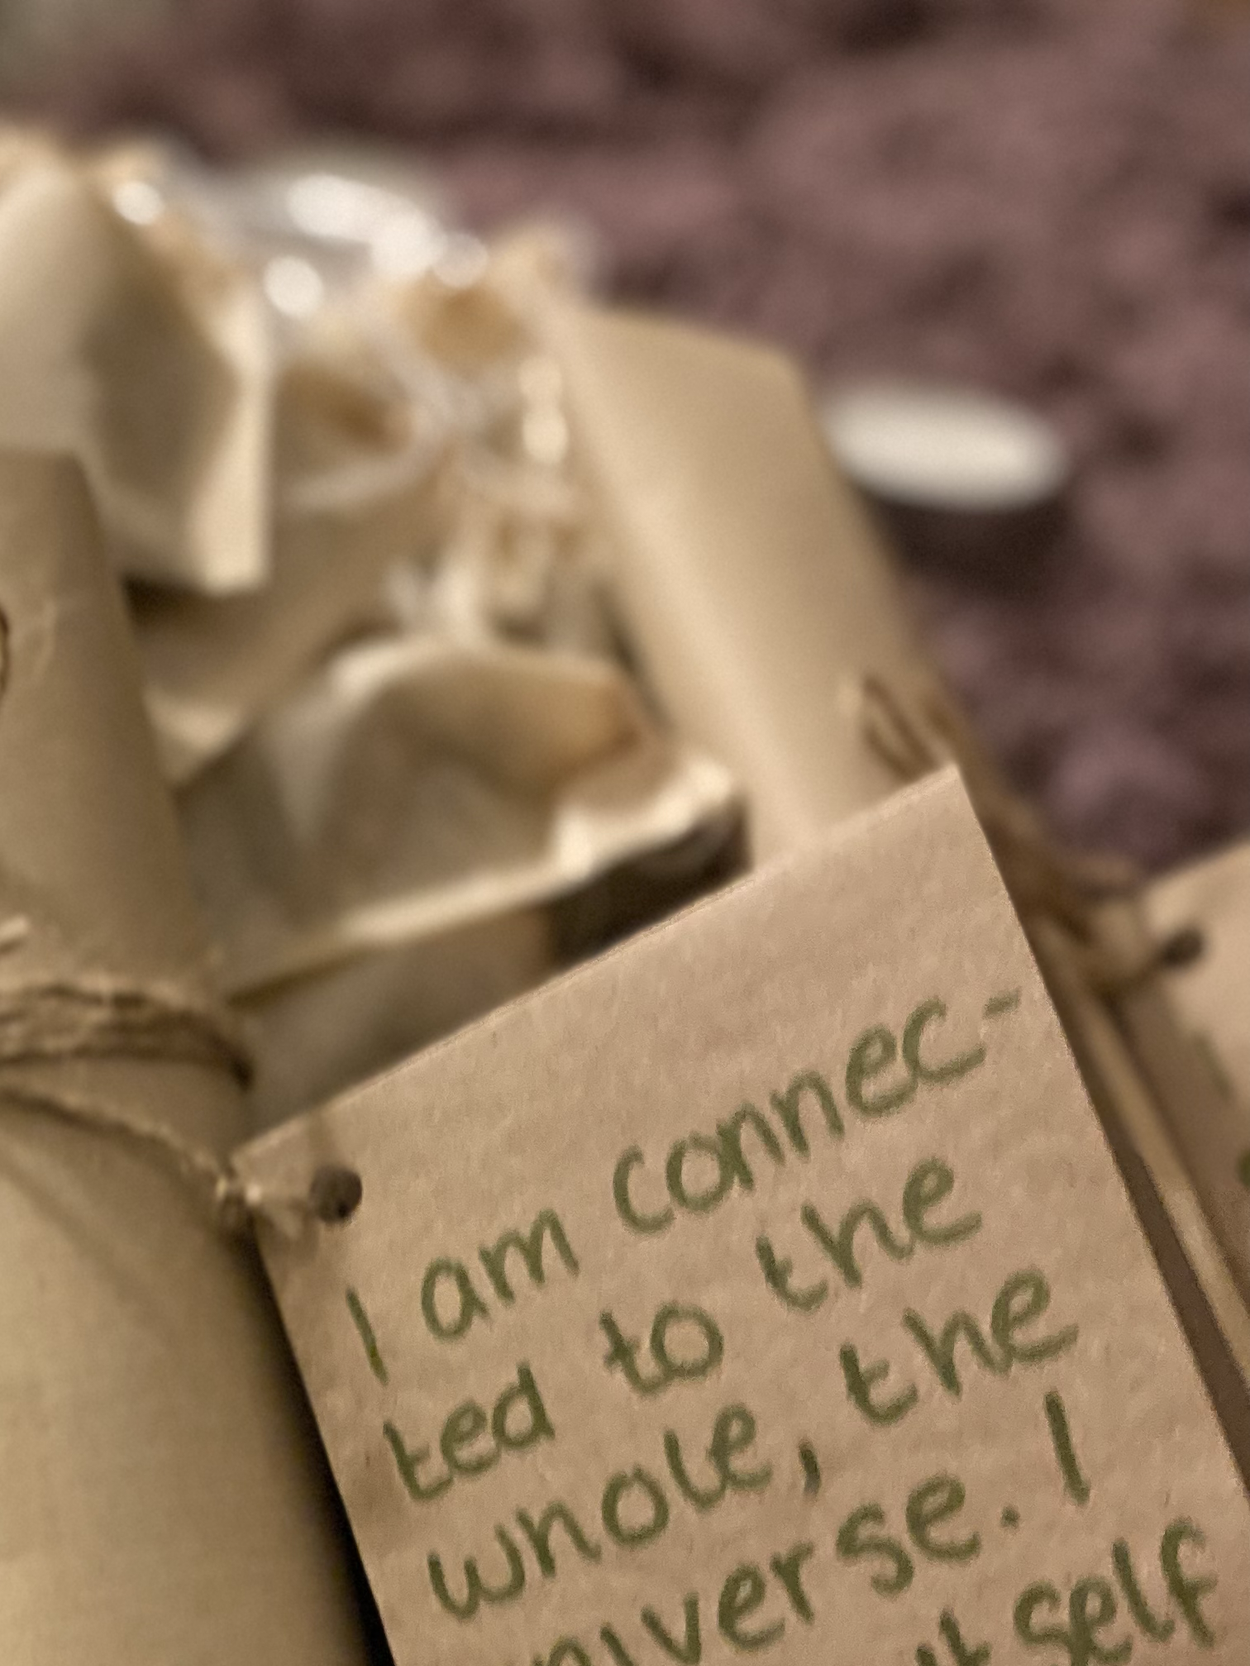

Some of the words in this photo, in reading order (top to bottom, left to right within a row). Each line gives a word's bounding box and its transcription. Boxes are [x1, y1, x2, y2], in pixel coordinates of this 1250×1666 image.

[346, 1285, 390, 1384] I
[419, 1206, 580, 1343] am
[611, 986, 1024, 1237] connec-
[383, 1362, 556, 1502] ted
[599, 1302, 726, 1396] to
[755, 1156, 984, 1312] the
[426, 1404, 823, 1620] whole,
[838, 1268, 1079, 1428] the
[1044, 1391, 1093, 1506] I
